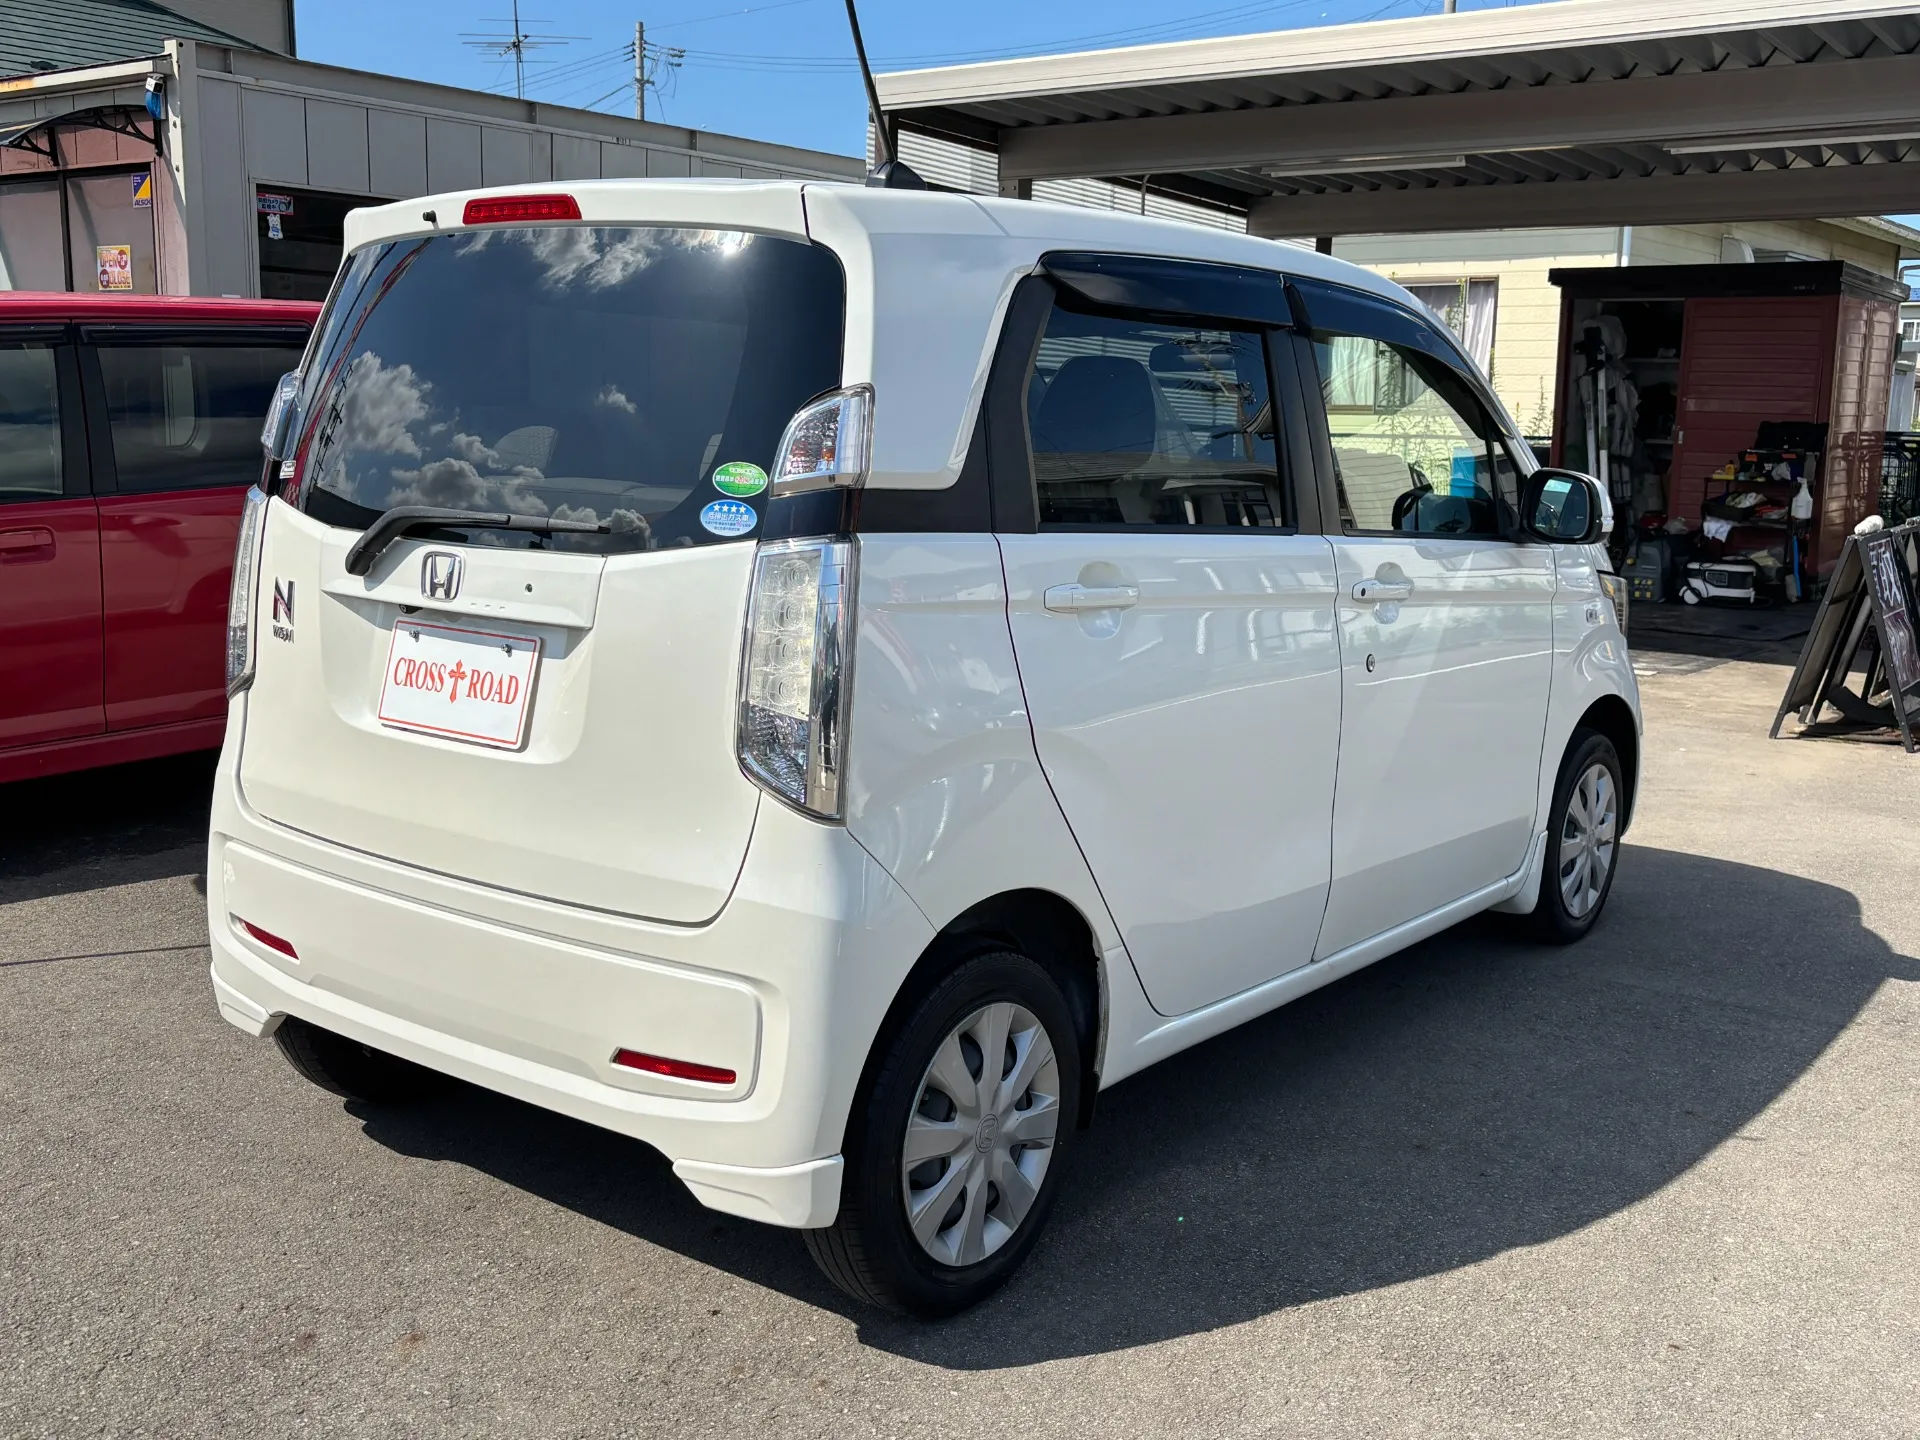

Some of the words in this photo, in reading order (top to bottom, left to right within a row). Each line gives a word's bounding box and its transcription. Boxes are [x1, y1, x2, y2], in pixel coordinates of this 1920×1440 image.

[272, 576, 296, 627] N
[394, 657, 447, 693] CROSS
[466, 669, 519, 705] ROAD
